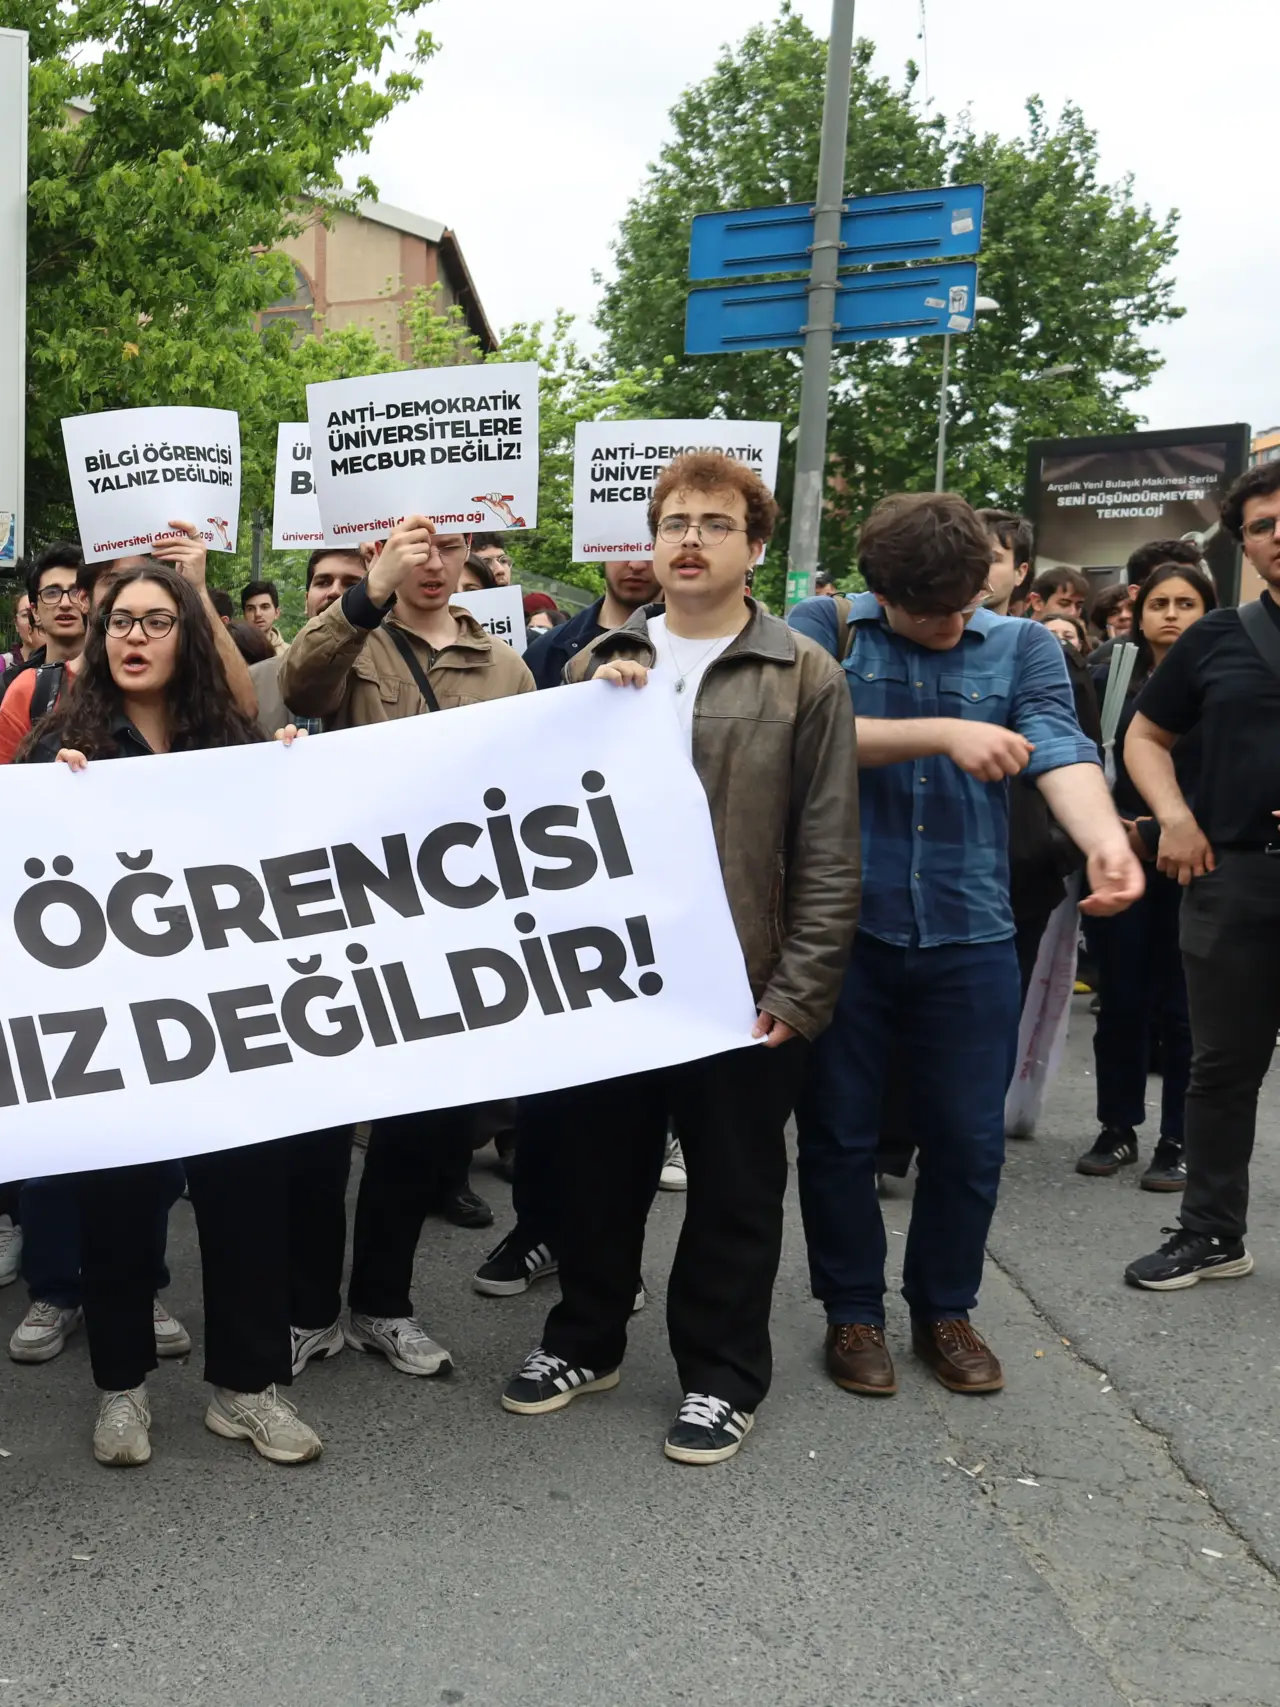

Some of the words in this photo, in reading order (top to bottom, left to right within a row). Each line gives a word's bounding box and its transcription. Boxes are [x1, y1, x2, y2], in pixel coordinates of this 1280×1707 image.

[328, 417, 522, 452] ÜNİVERSİTELERE
[85, 444, 140, 473] BİLGİ
[143, 442, 232, 466] ÖĞRENCİSİ
[331, 448, 426, 477] MECBUR
[430, 438, 522, 465] DEĞİLİZ!
[88, 470, 160, 495] YALNIZ
[162, 464, 233, 488] DEĞİLDİR!
[1047, 482, 1081, 493] Arçelik
[1083, 480, 1104, 490] Yeni
[1105, 478, 1141, 490] Bulaşık
[1142, 476, 1186, 488] Makinesi
[1188, 473, 1218, 485] Serisi
[1057, 492, 1087, 507] SENİ
[1088, 489, 1205, 505] DÜŞÜNDÜRMEYEN
[1097, 503, 1164, 519] TEKNOLOJİ
[333, 516, 395, 535] üniversiteli
[466, 511, 485, 523] ağı
[93, 533, 153, 553] üniversiteli
[583, 543, 643, 553] üniversiteli
[13, 771, 634, 970] ÖĞRENCİSİ
[128, 911, 664, 1085] DEĞİLDİR!
